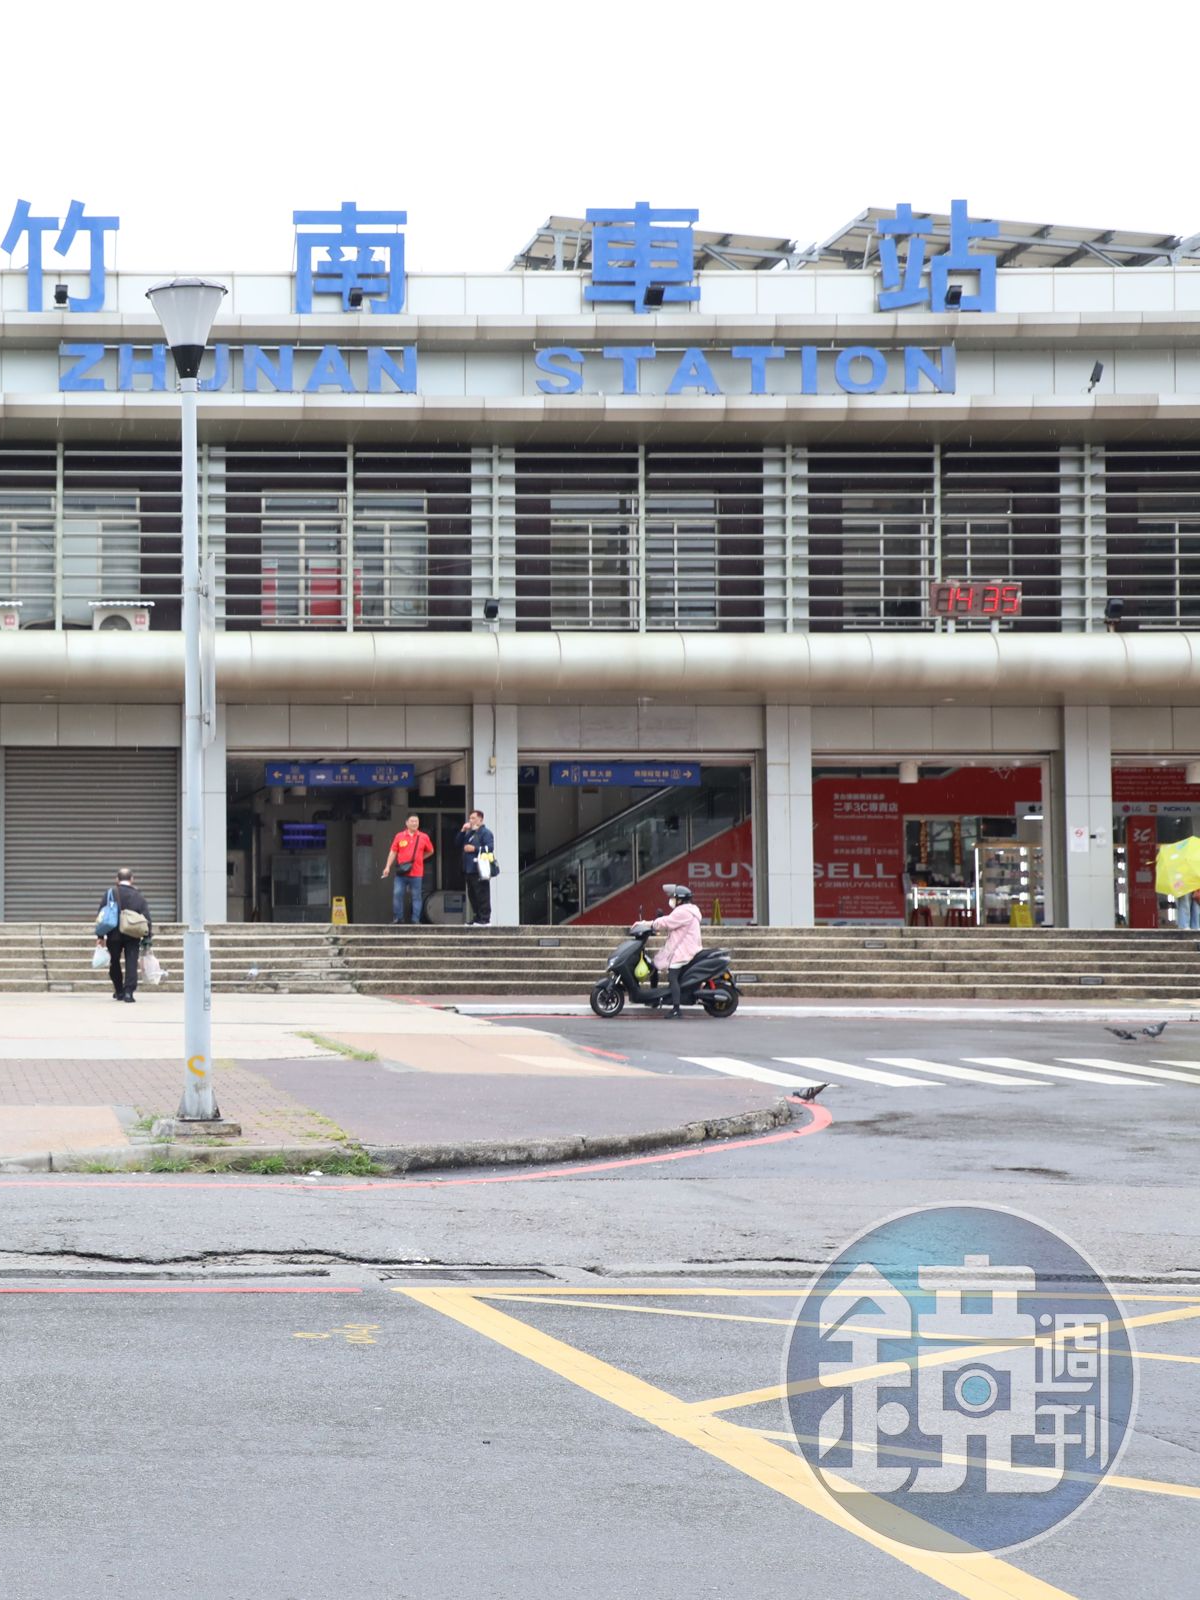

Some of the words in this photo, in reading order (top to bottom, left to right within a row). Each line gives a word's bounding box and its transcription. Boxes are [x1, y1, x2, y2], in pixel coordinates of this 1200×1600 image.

[0, 198, 998, 314] 竹南車站
[534, 345, 956, 394] STATION
